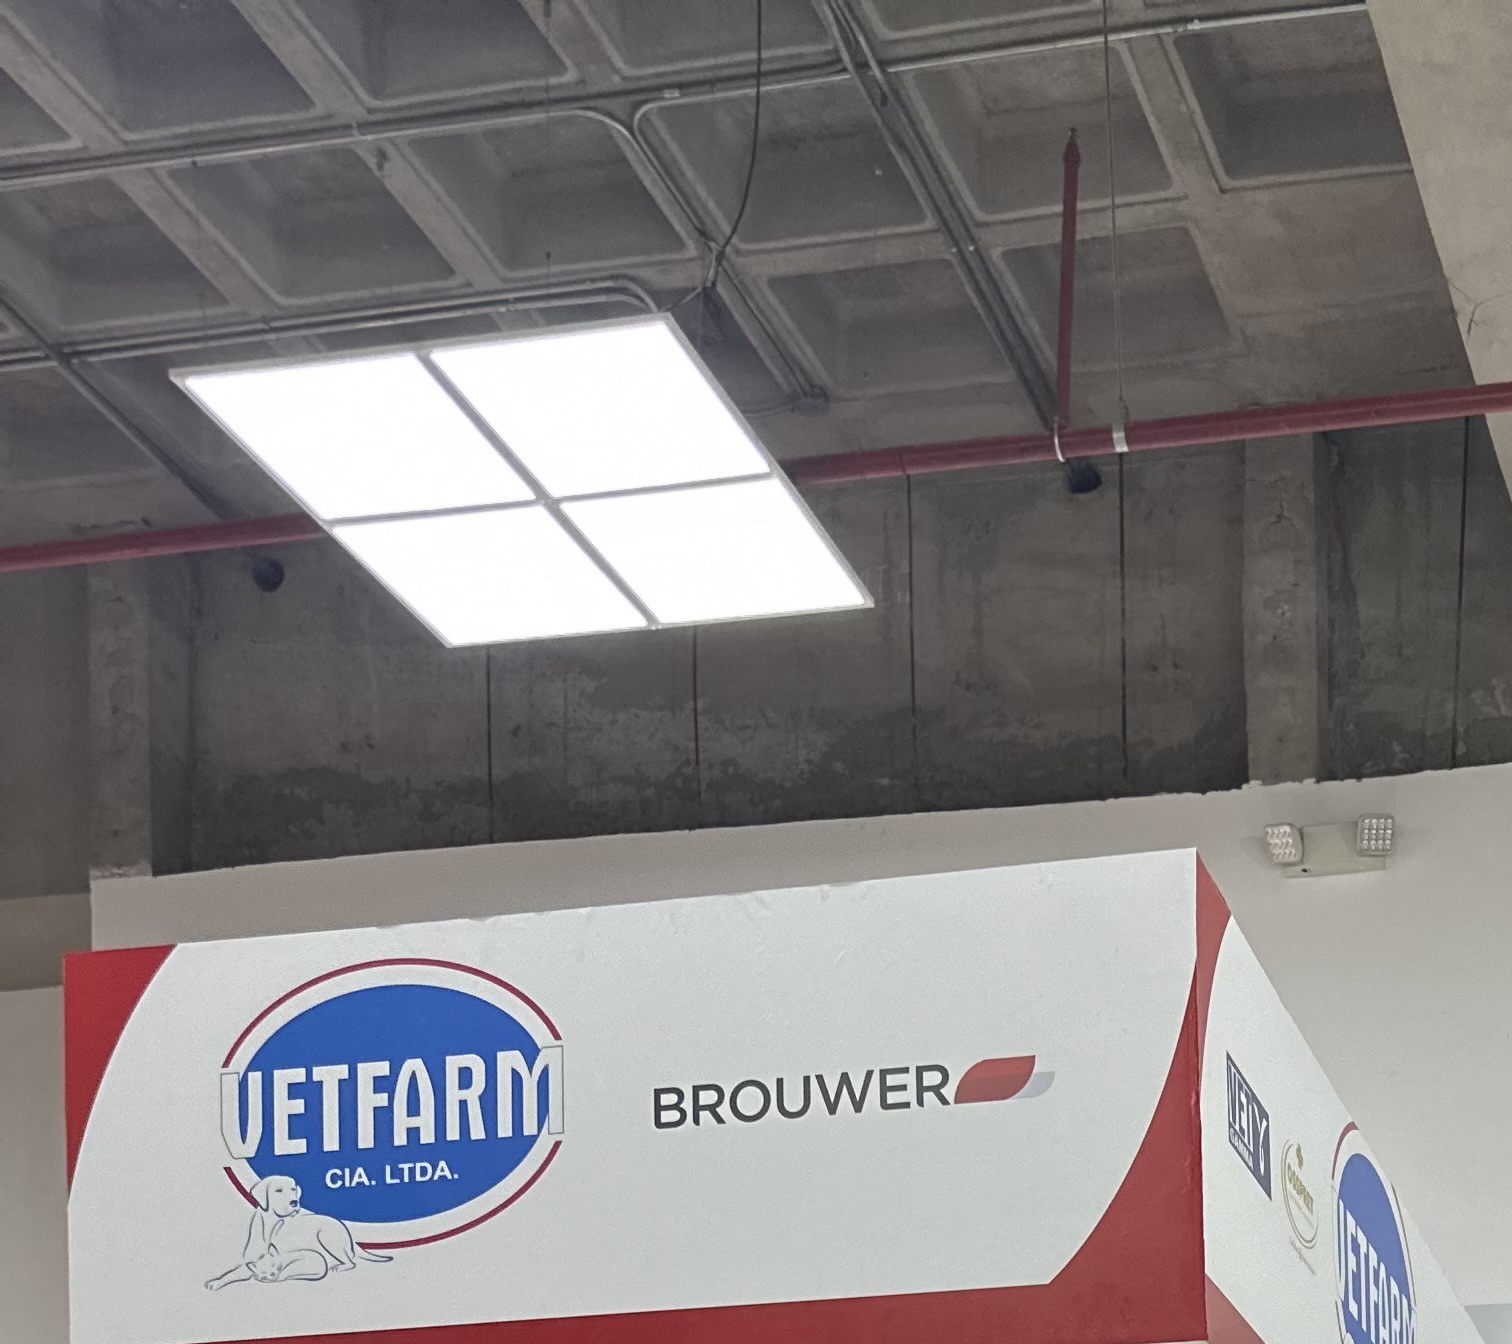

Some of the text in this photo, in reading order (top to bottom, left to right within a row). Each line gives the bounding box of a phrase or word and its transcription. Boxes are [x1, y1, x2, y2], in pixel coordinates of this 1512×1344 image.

[220, 1045, 564, 1161] VETFARM
[652, 1063, 953, 1130] BROUWER
[324, 1158, 460, 1191] CIA. LTDA.
